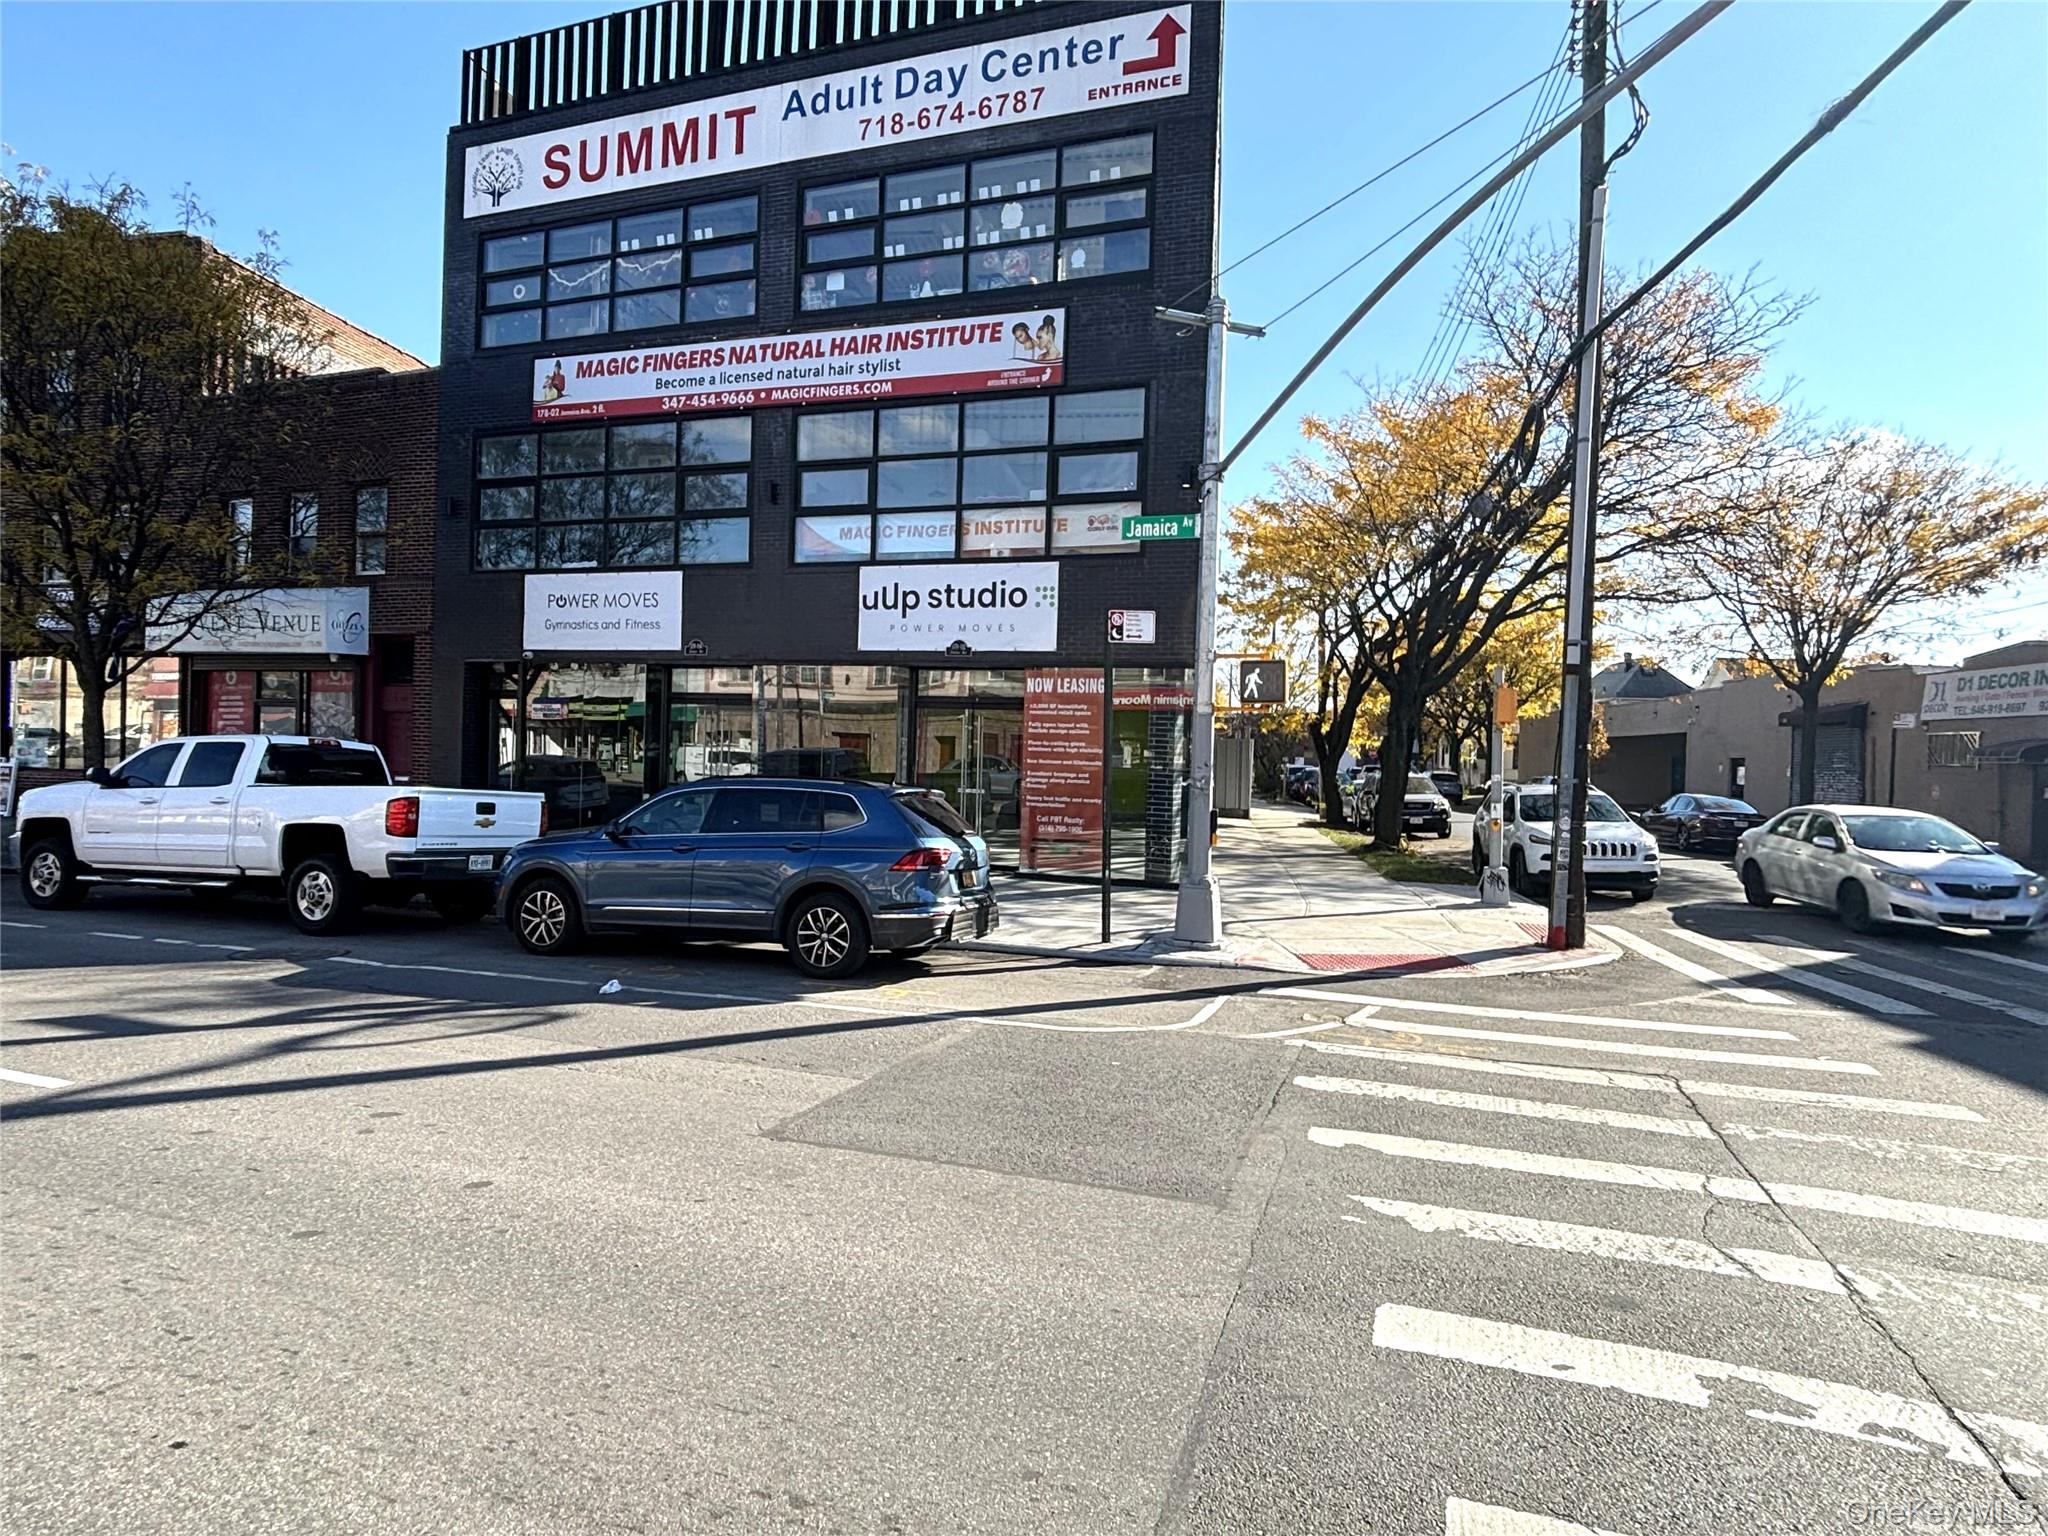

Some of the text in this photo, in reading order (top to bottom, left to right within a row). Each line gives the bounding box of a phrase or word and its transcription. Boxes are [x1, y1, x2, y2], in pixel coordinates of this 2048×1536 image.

[781, 33, 1125, 121] Adult Day Center
[1087, 73, 1183, 101] ENTRANCE
[859, 86, 1046, 141] 718-674-6787
[542, 105, 757, 190] SUMMIT
[575, 321, 1004, 379] MAGIC FINGERS NATURAL HAIR INSTITUTE
[655, 357, 901, 390] Become a licensed natural hair stylist
[661, 382, 892, 410] 347-454-9666 MAGICFINGERS.COM
[1126, 516, 1194, 538] Jamaica Av
[603, 592, 659, 609] MOVES
[927, 579, 1028, 609] studio
[252, 606, 322, 634] VENUE
[544, 617, 661, 633] Gymnastics and Fitness
[889, 623, 1016, 633] POWER MOVES
[1026, 677, 1105, 694] NOW LEASING
[1957, 677, 1974, 692] D1
[1977, 671, 2030, 691] DECOR
